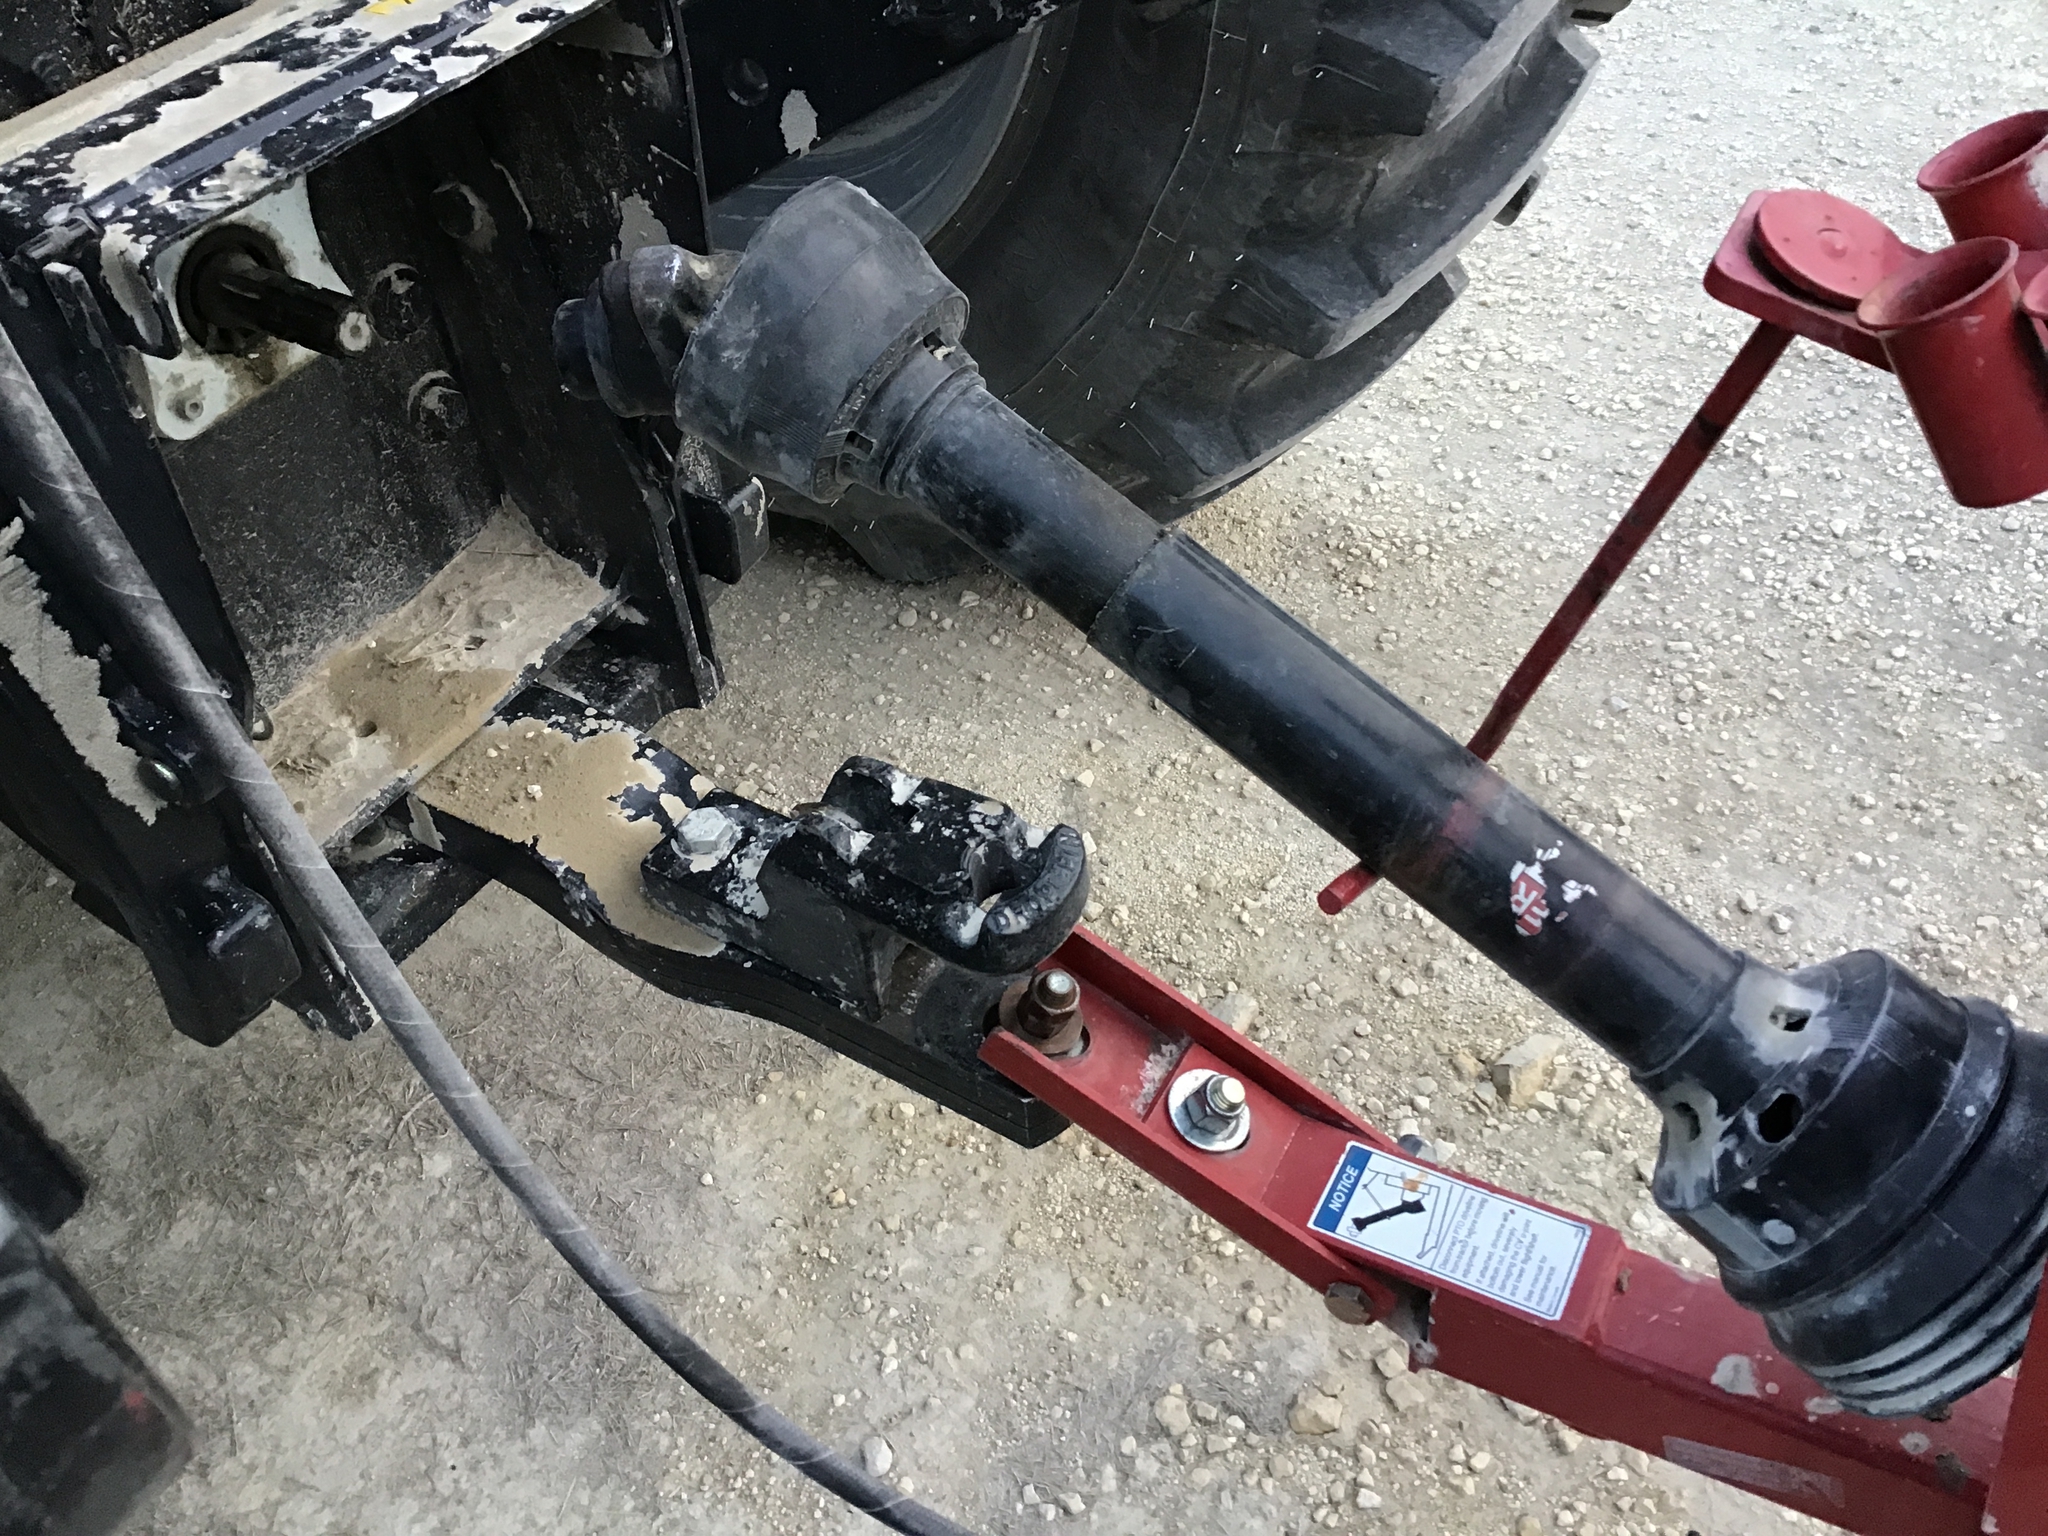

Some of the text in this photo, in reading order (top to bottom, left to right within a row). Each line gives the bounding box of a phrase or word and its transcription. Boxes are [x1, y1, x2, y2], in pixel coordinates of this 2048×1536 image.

[1328, 1165, 1359, 1212] NOTICE
[1438, 1195, 1476, 1271] Disconnect PTO driveline
[1449, 1259, 1461, 1274] from
[1464, 1219, 1478, 1239] before
[1473, 1197, 1489, 1220] moving
[1490, 1223, 1506, 1250] driveline
[1502, 1211, 1510, 1223] will
[1486, 1266, 1501, 1289] bottom
[1502, 1226, 1518, 1253] severely
[1498, 1261, 1517, 1293] damaging
[1510, 1250, 1520, 1261] the
[1513, 1266, 1526, 1284] lower
[1523, 1255, 1547, 1303] See manual for
[1509, 1283, 1519, 1297] and
